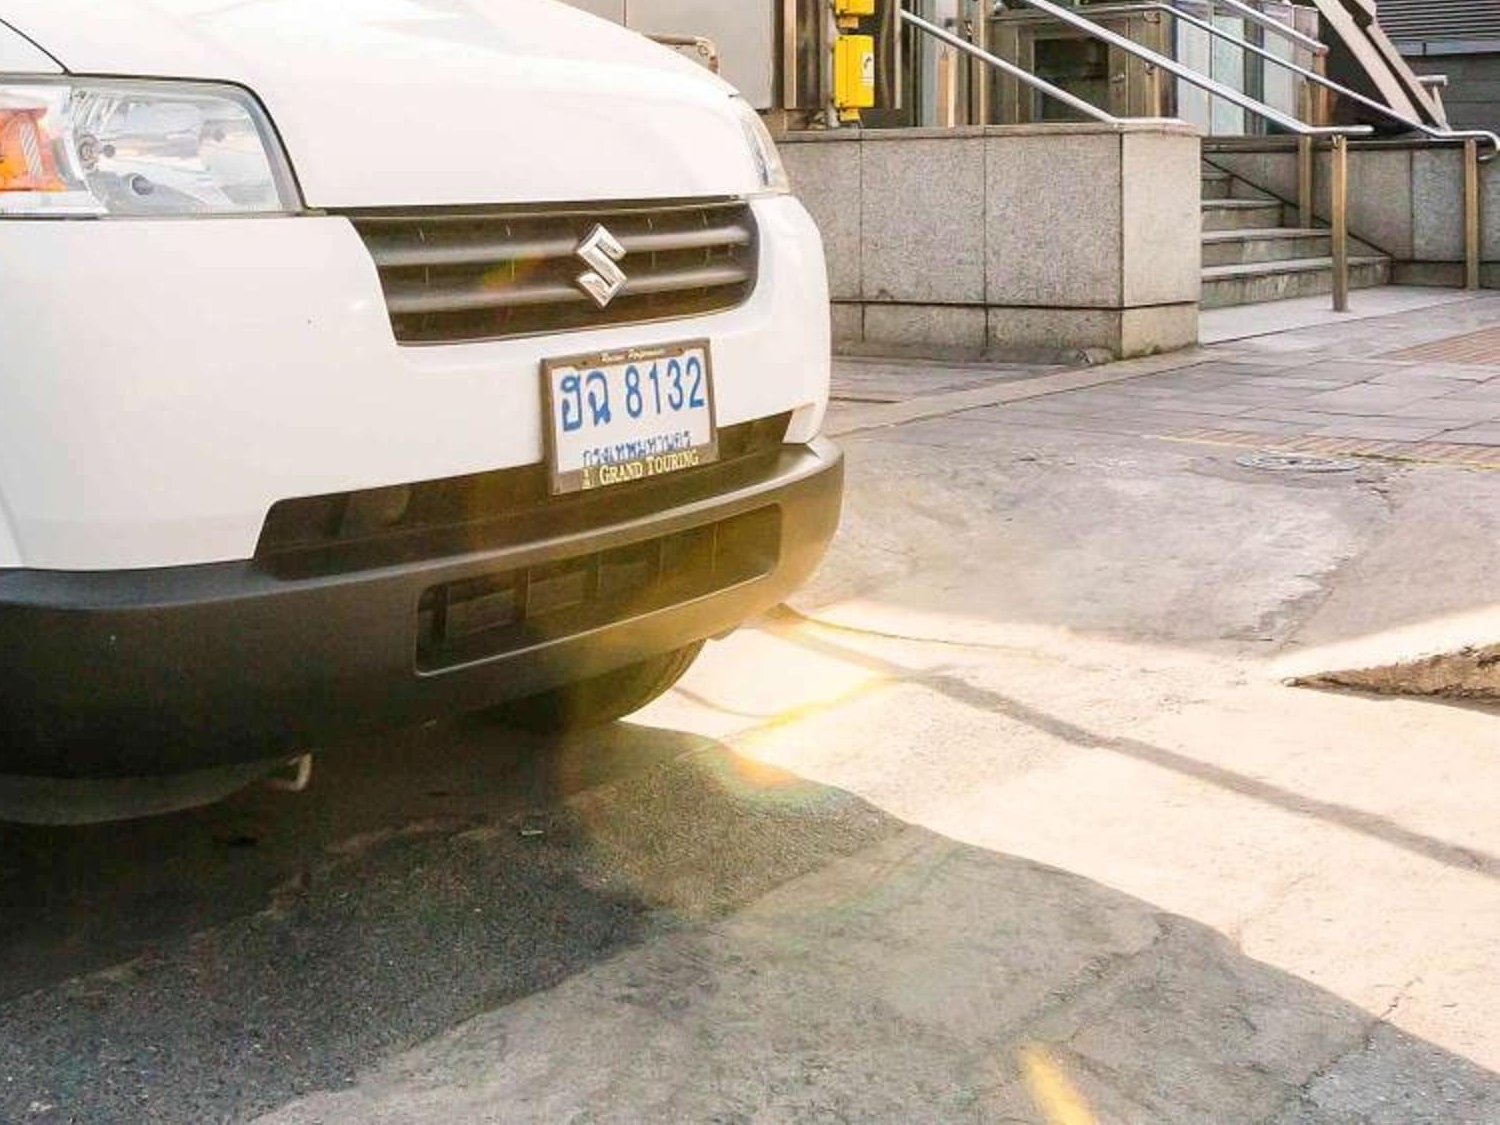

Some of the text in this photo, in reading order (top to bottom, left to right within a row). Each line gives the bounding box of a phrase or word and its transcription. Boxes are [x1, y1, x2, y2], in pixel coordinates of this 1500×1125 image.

[624, 355, 706, 419] 8132
[583, 430, 692, 466] กรงเทพมหานคร
[599, 448, 700, 486] GRAND TOURING
